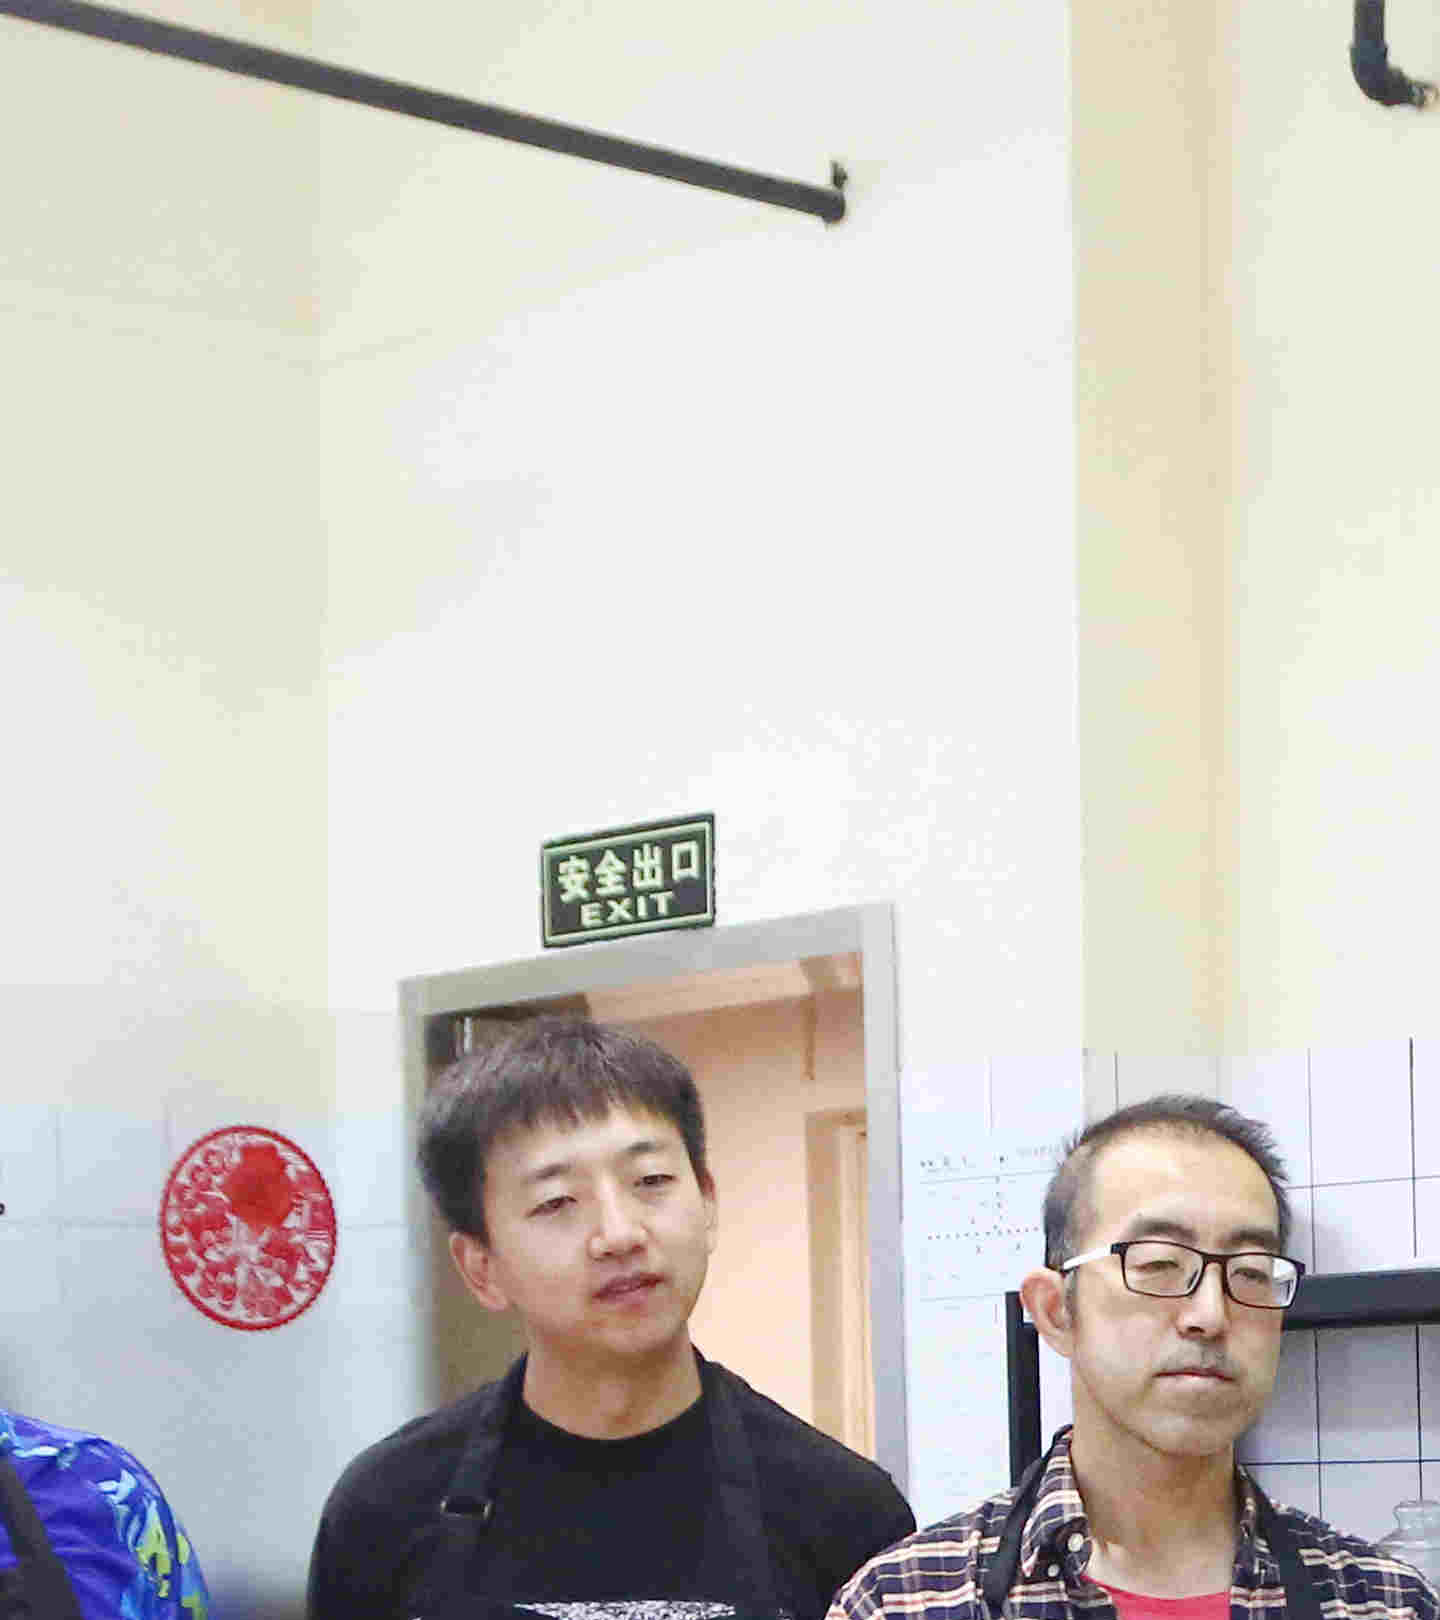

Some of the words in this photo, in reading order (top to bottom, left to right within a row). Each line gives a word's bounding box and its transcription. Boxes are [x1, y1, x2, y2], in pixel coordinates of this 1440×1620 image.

[557, 840, 700, 905] 安全出口
[581, 889, 674, 928] EXIT
